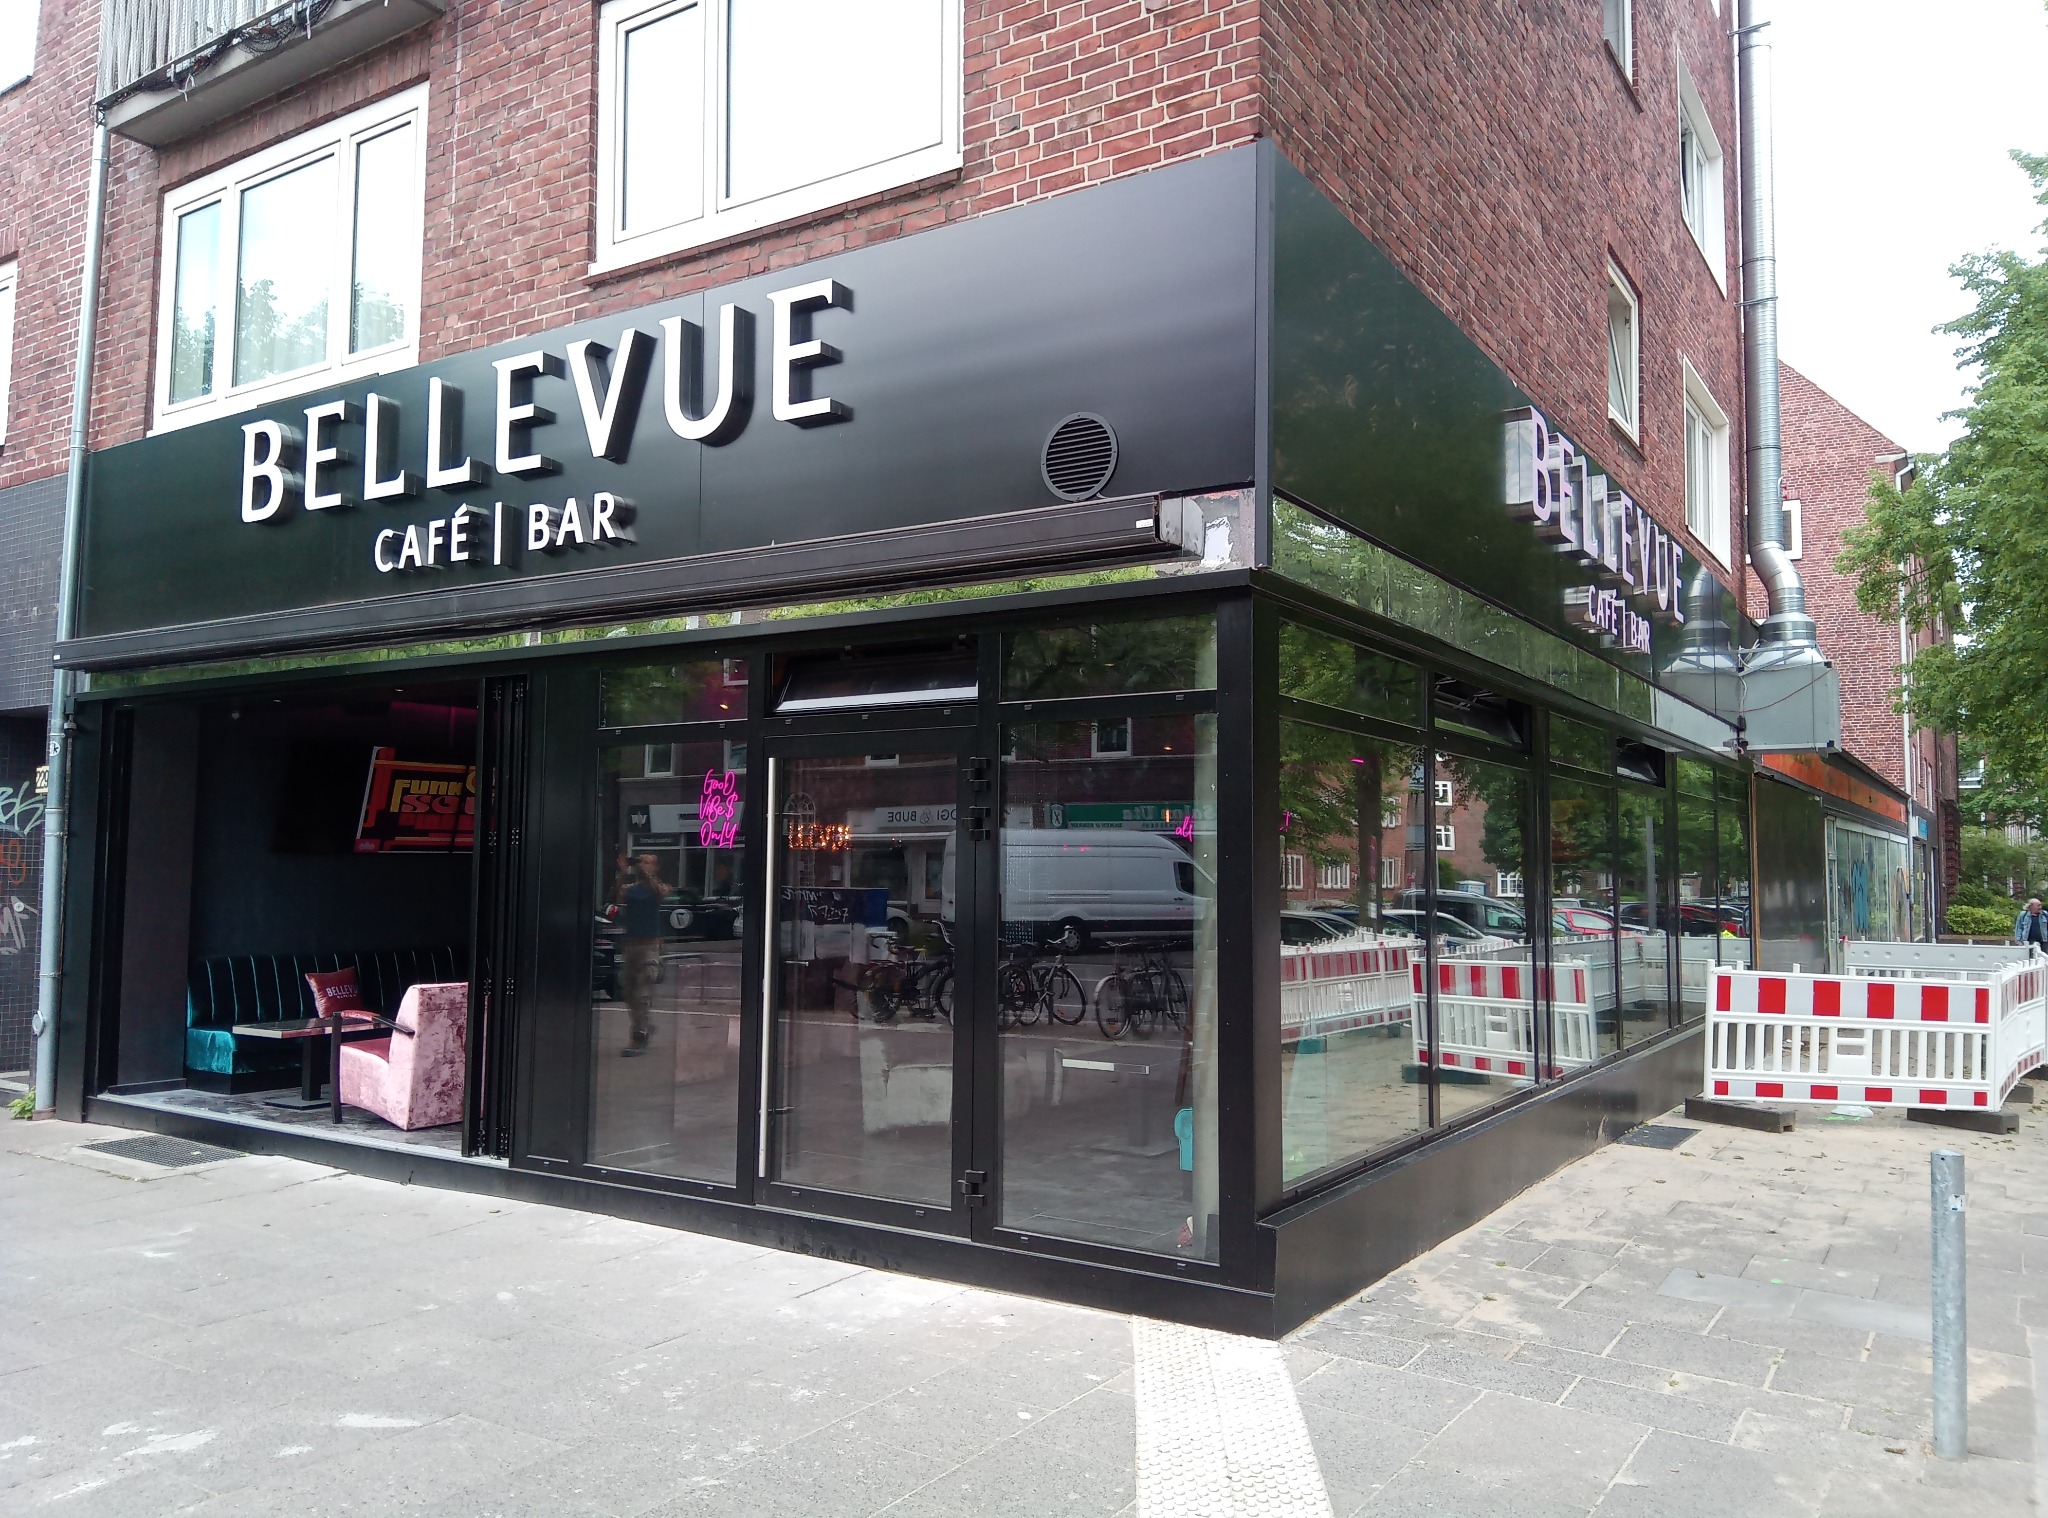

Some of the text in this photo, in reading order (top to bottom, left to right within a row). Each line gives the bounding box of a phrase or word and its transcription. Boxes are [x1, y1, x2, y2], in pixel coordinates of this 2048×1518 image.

[241, 278, 848, 523] BELLEVUE
[374, 502, 471, 573] CAFÉ
[527, 490, 619, 553] BAR
[1531, 405, 1684, 624] BELLEVUE
[1588, 584, 1618, 636] CAFÉ
[1630, 610, 1652, 655] BAR
